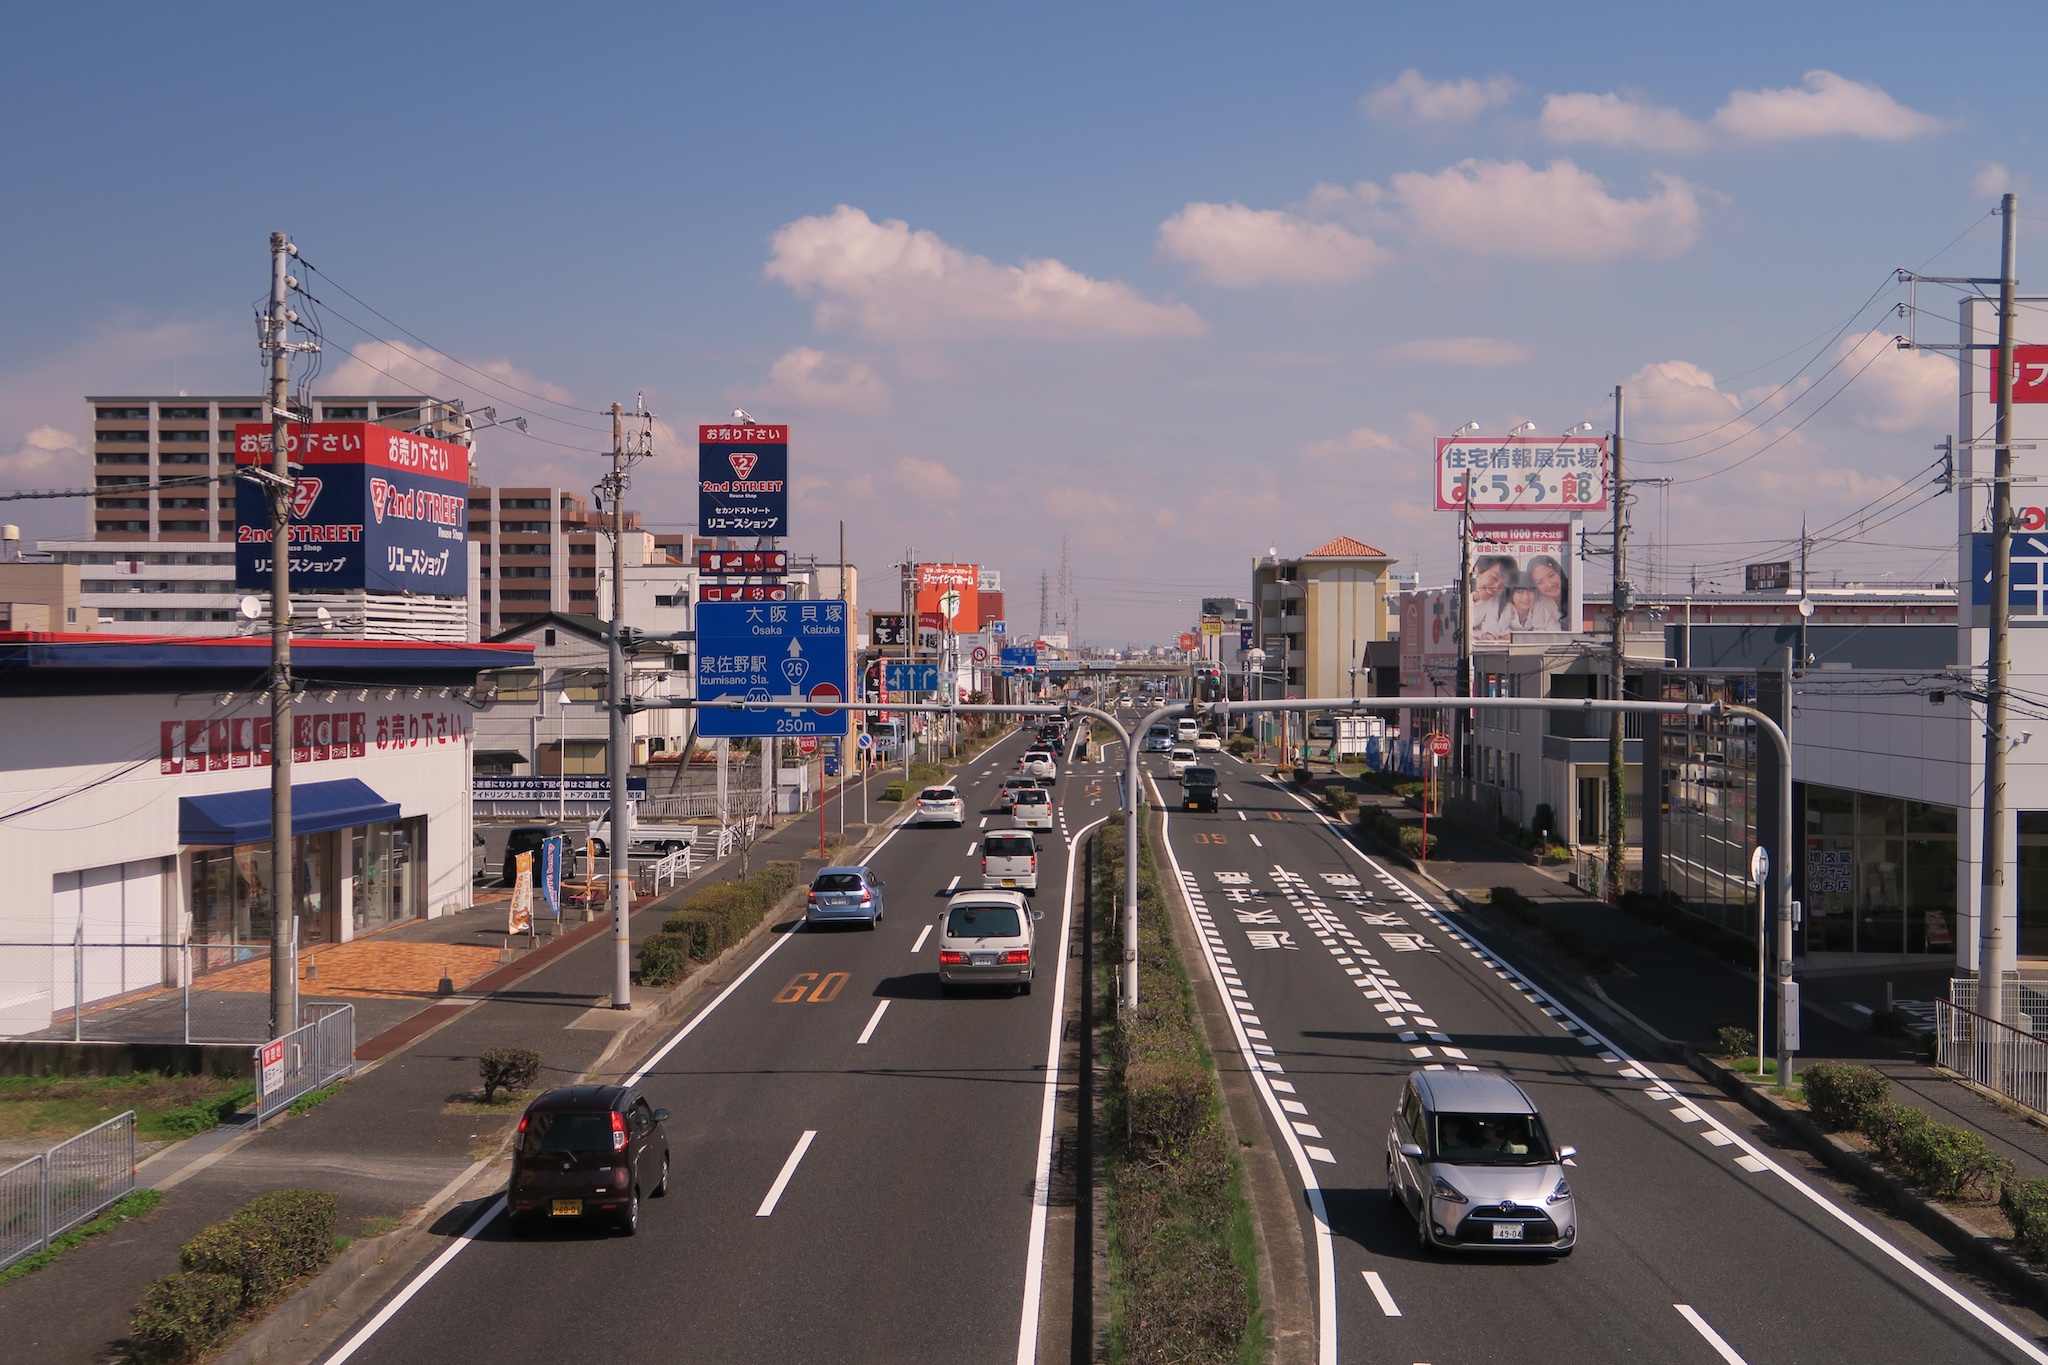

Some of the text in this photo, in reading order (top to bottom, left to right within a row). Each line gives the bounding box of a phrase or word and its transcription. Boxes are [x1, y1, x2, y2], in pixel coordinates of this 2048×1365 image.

[706, 428, 781, 440] お売り下さい
[240, 433, 361, 453] お売り下さい
[388, 435, 449, 472] お売り下さい
[1445, 447, 1598, 468] 住宅情報展示場
[703, 481, 783, 493] 2nd STREET
[387, 484, 464, 527] 2nd STREET
[714, 506, 770, 515] セカンドストリート
[706, 517, 778, 529] リユースショップ
[287, 525, 363, 542] STREET
[303, 544, 322, 553] Shop
[254, 557, 346, 573] リスショップ
[388, 546, 449, 577] リユースショップ
[746, 605, 843, 623] 大阪 貝塚
[752, 625, 840, 635] Osaka Kaizuka
[700, 655, 768, 673] 泉佐野駅
[787, 662, 802, 677] 26
[700, 675, 769, 685] Izumisano Sta.
[375, 712, 462, 750] お売り下さい
[776, 719, 816, 732] 250m
[1809, 850, 1852, 864] 増改築
[1809, 864, 1851, 877] リフォーム
[1809, 880, 1851, 892] のお店
[772, 971, 851, 1003] 60
[1500, 1230, 1521, 1239] 49-04
